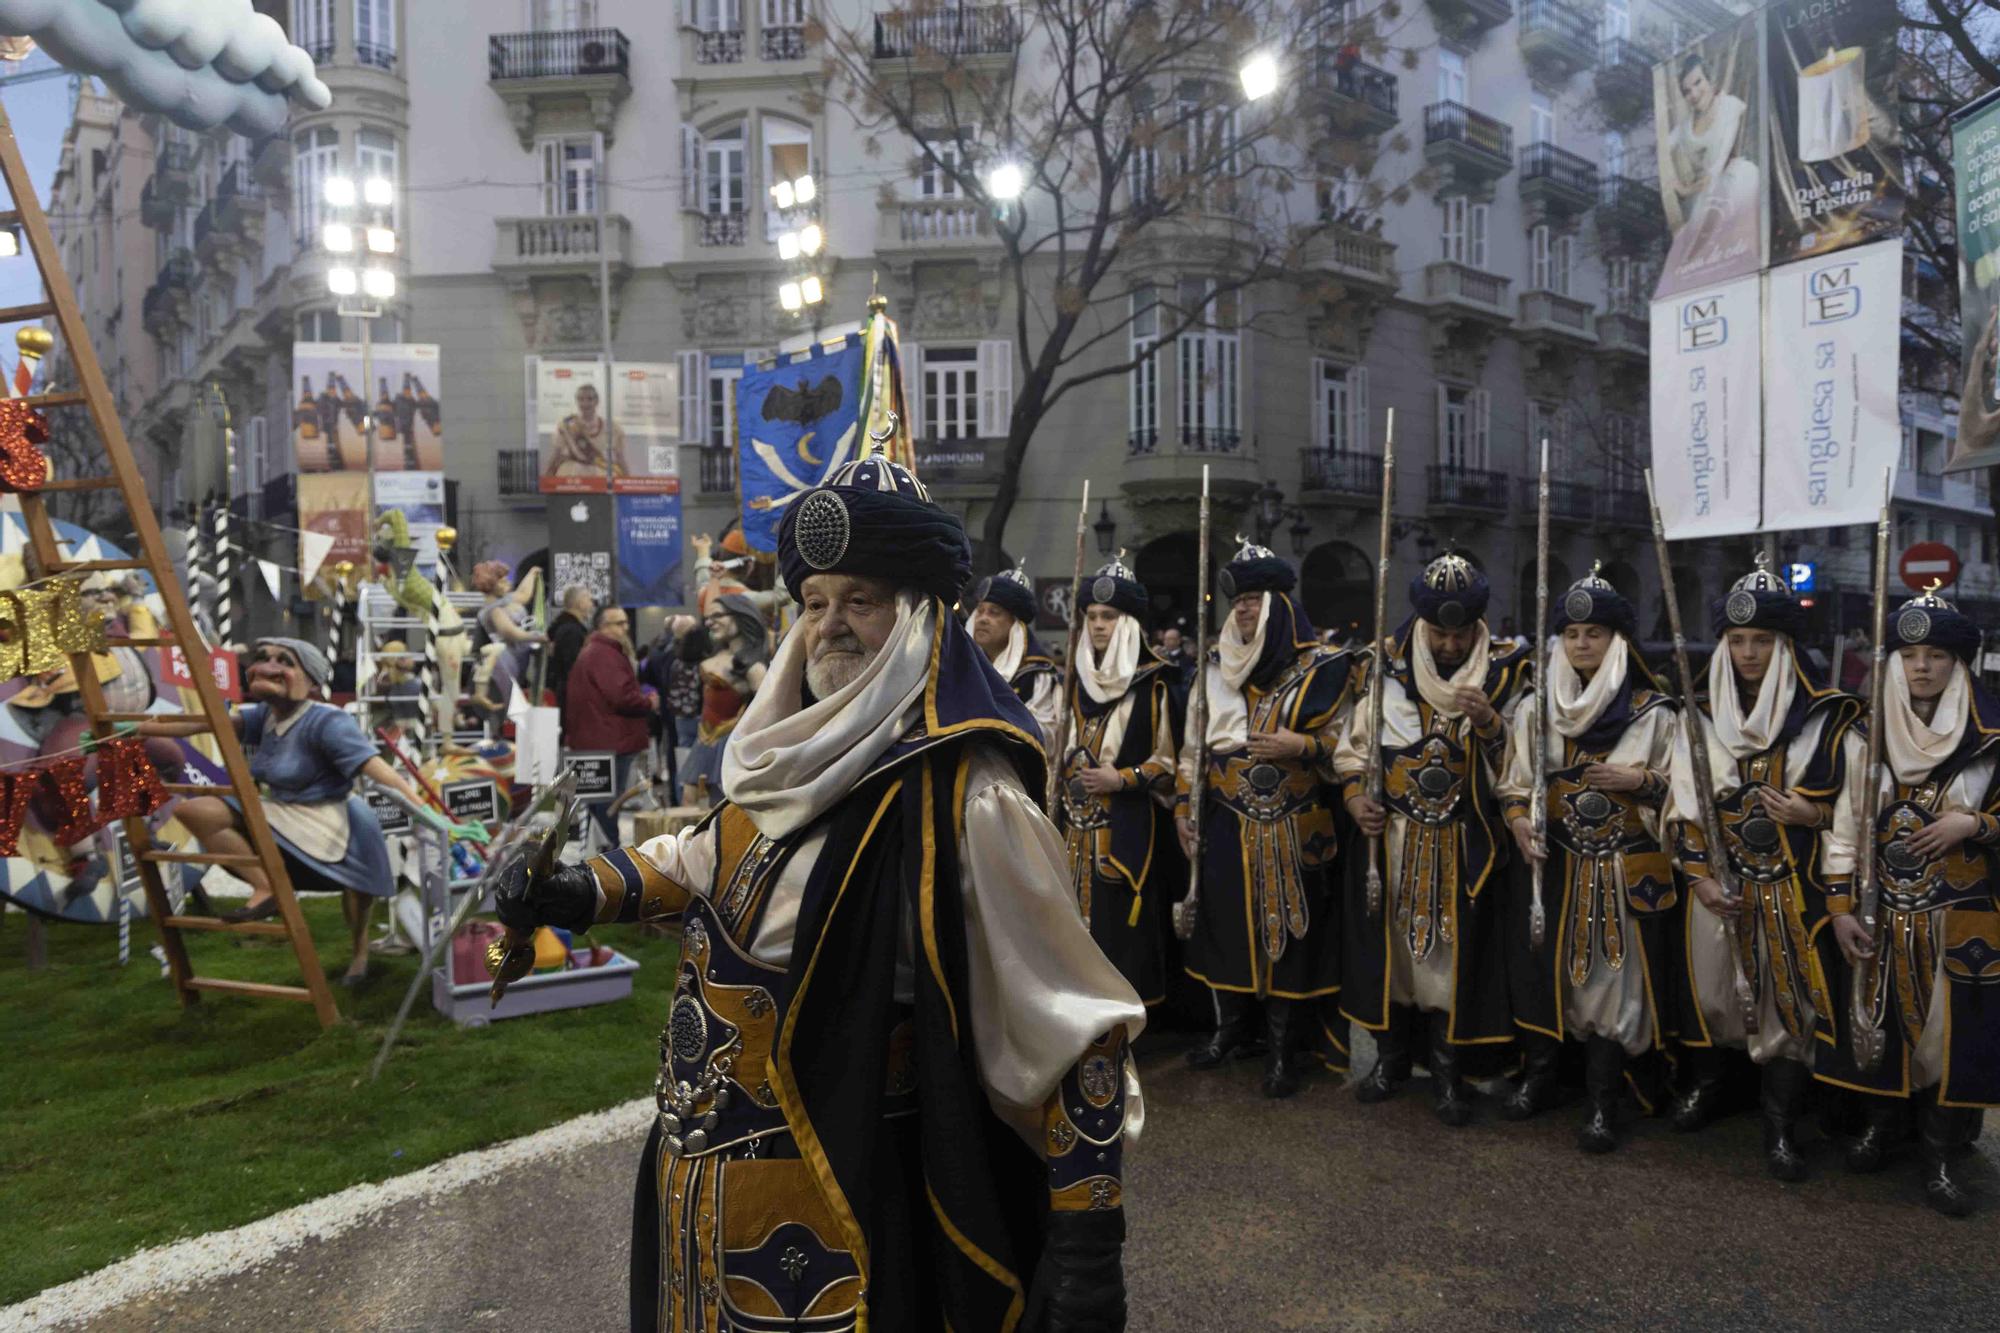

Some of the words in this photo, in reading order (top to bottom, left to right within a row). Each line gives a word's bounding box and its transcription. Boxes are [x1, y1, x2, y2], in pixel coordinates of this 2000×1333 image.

[1829, 171, 1874, 193] arda
[1967, 174, 1979, 193] el
[1968, 214, 1980, 233] al
[1816, 340, 1836, 369] sa
[1689, 366, 1707, 392] sa
[1804, 380, 1840, 507] sangüesa
[1687, 401, 1715, 517] sangüesa
[1791, 563, 1812, 584] P
